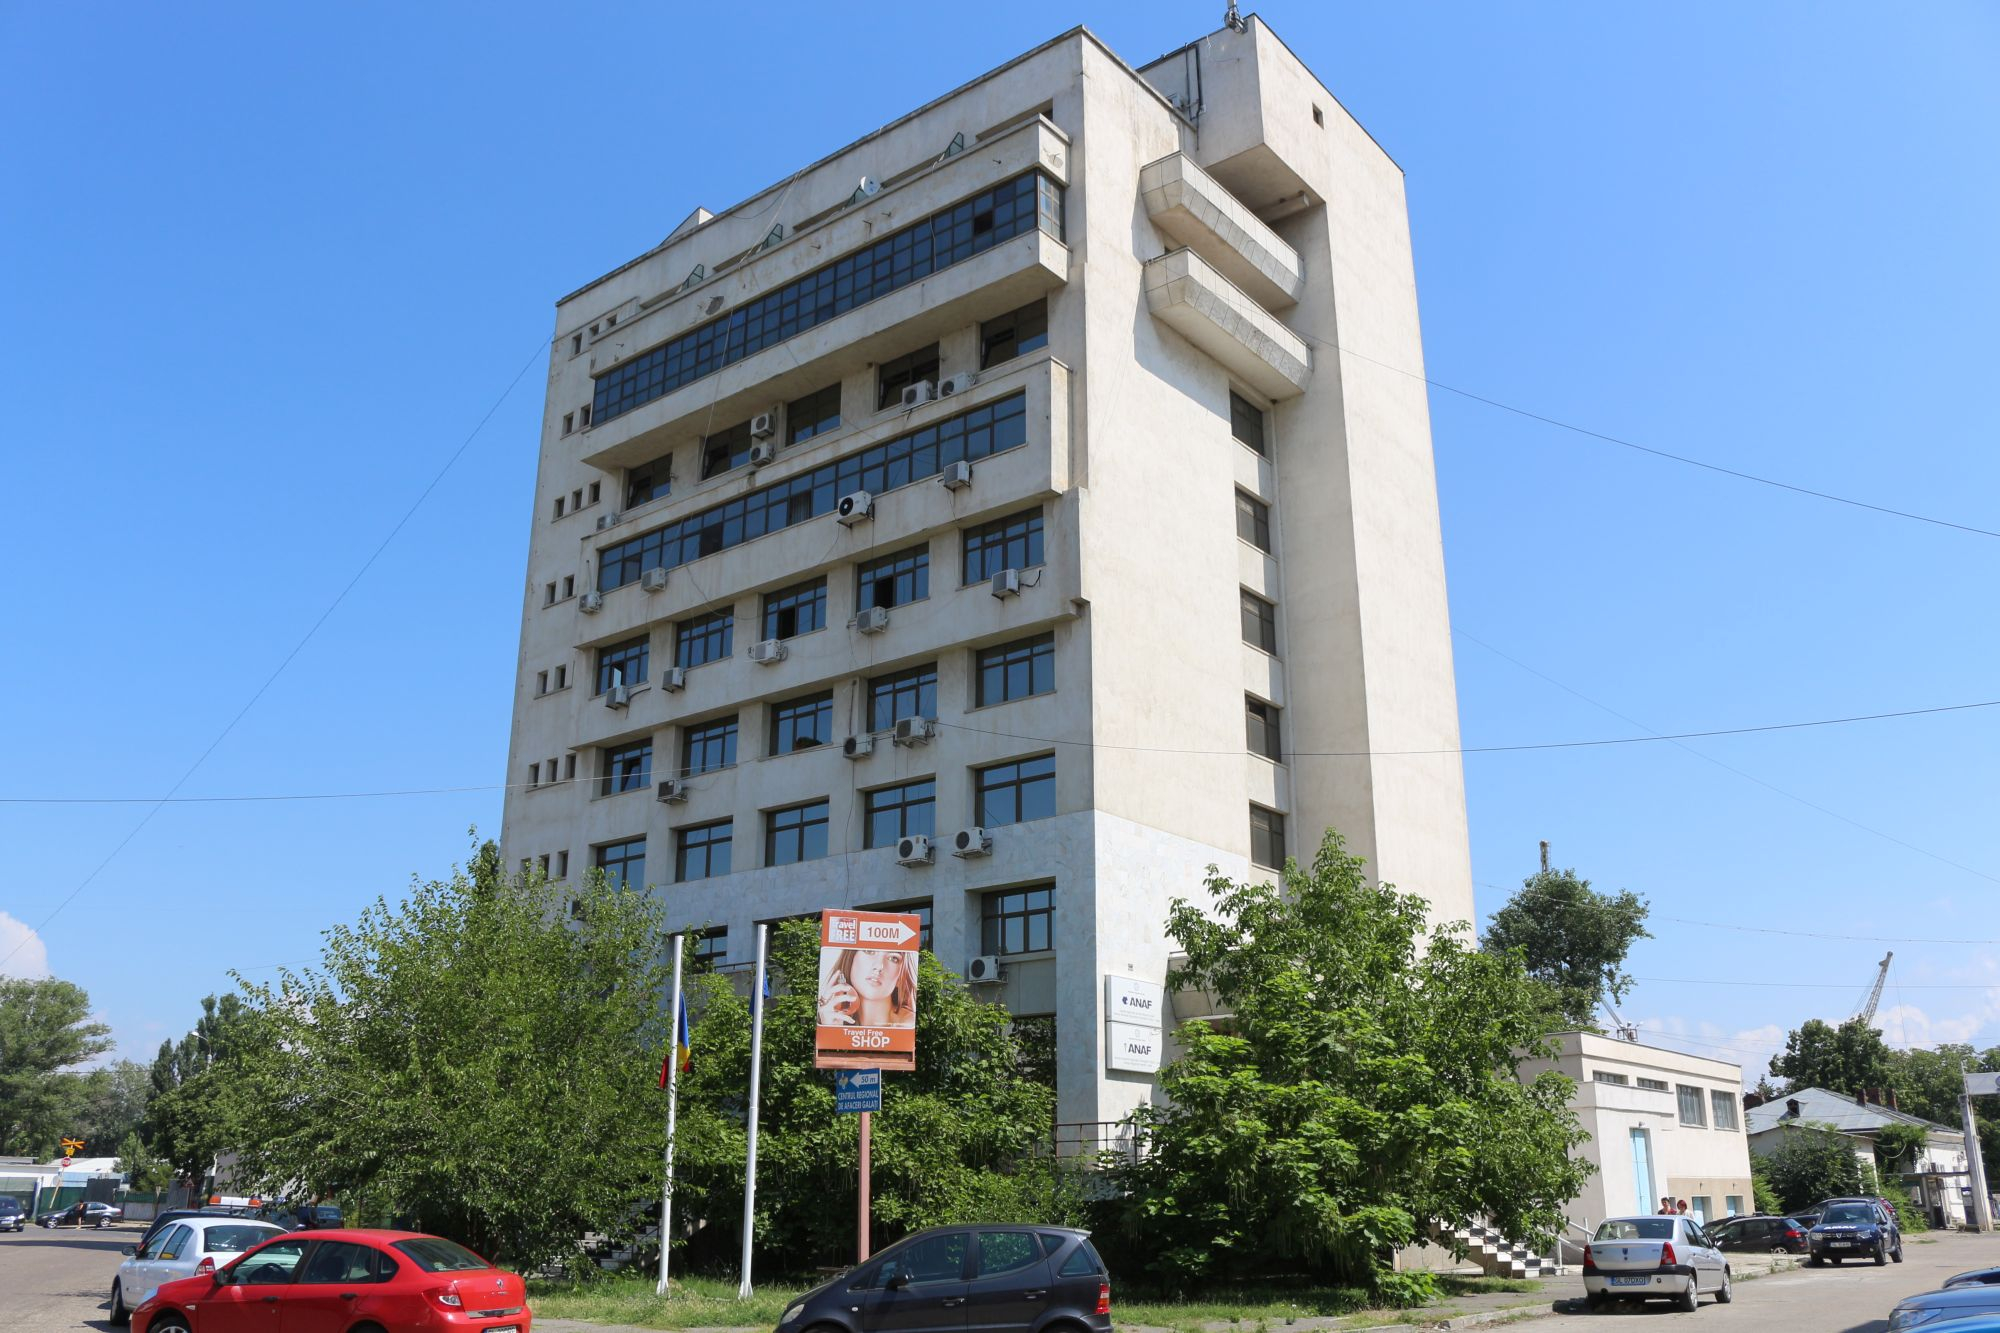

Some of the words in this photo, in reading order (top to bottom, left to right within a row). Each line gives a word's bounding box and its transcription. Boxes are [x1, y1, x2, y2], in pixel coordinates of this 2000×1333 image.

[867, 926, 899, 939] 100M
[1130, 997, 1152, 1009] ANAF
[843, 1028, 866, 1036] Travel
[867, 1029, 884, 1037] Free
[851, 1036, 890, 1048] SHOP
[1128, 1043, 1151, 1055] ANAF
[838, 1092, 855, 1100] CENTRUL
[857, 1090, 878, 1098] REGIONAL
